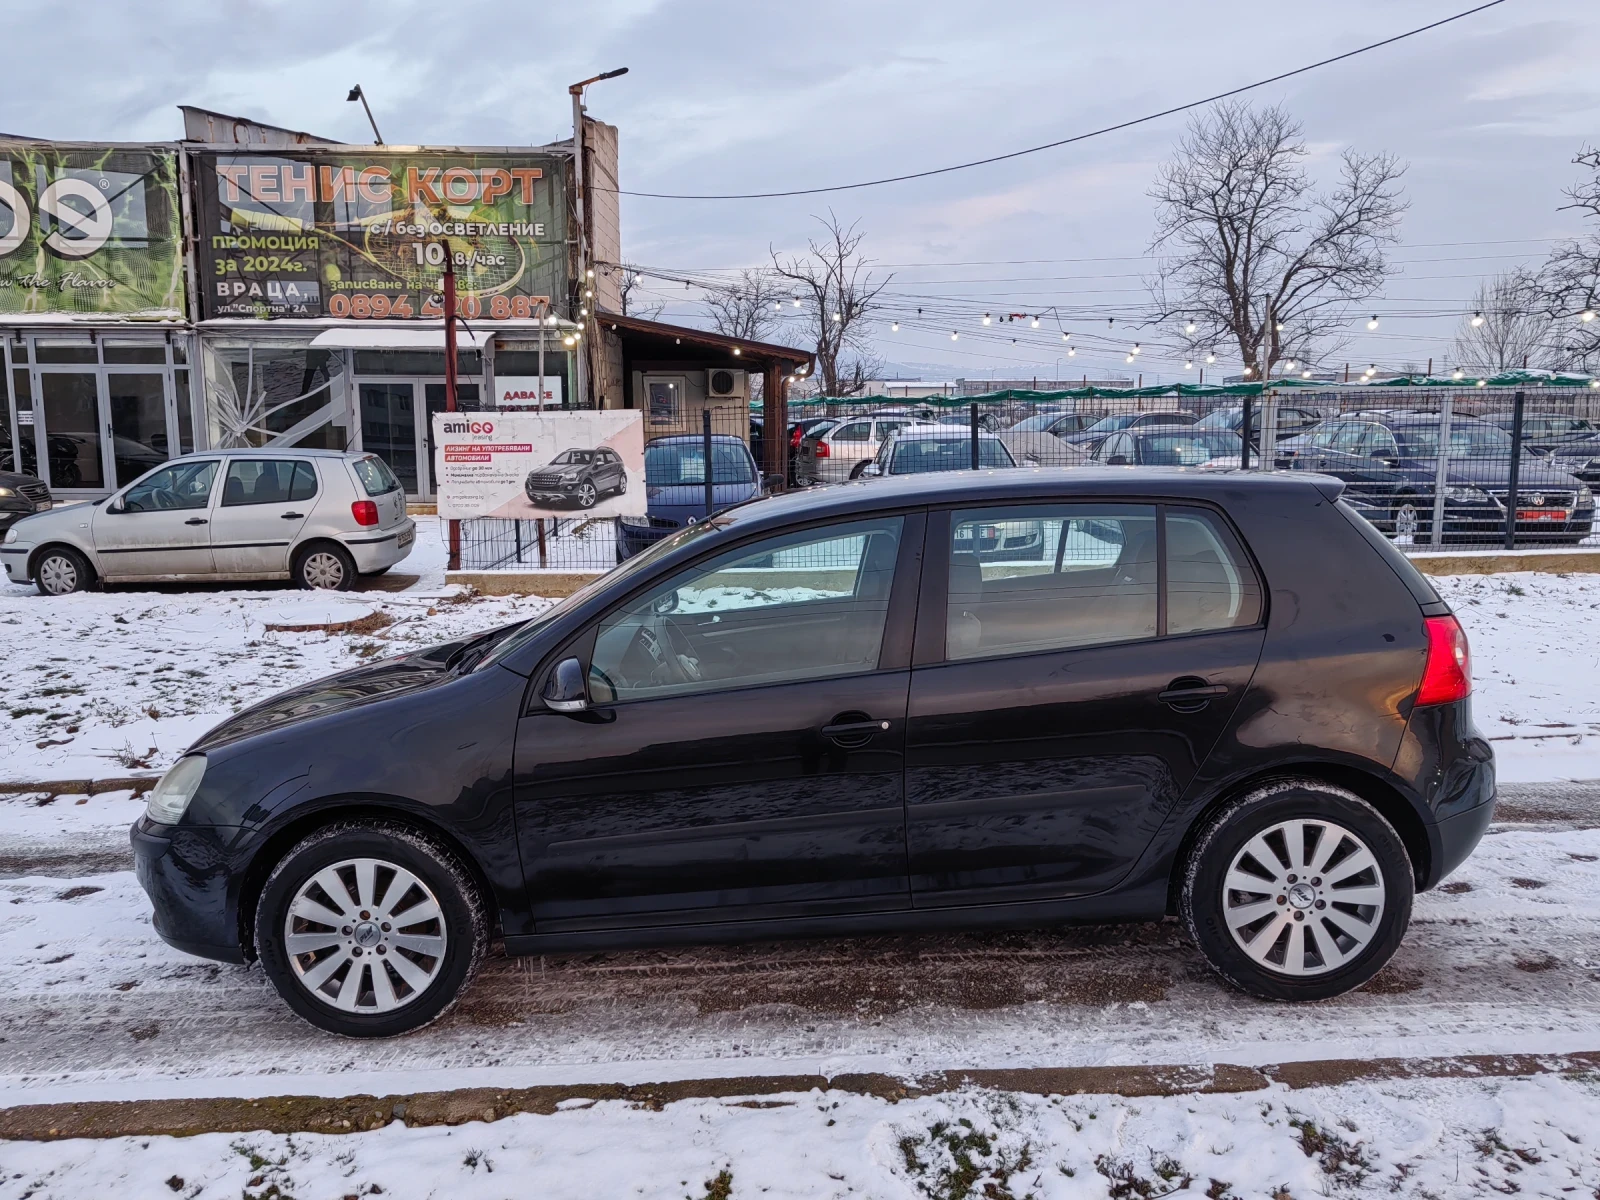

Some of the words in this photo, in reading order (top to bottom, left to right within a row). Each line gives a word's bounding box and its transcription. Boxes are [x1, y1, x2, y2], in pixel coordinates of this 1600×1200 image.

[216, 164, 393, 204] ТЕНИС
[406, 166, 543, 205] КОРТ
[396, 220, 425, 238] без
[429, 221, 545, 237] ОСВЕТЛЕНИЕ
[212, 235, 319, 252] ПРОМОЦИЯ
[215, 259, 238, 275] за
[243, 256, 308, 272] 2024г.
[18, 273, 51, 287] the
[60, 272, 116, 291] Flavor
[330, 278, 402, 291] записване
[406, 281, 423, 290] на
[426, 280, 478, 290] чаве:
[216, 282, 308, 299] ВРАЦА,
[293, 305, 308, 313] 2А
[329, 293, 414, 319] 0894
[490, 294, 549, 320] 887
[503, 391, 536, 401] ДАВА
